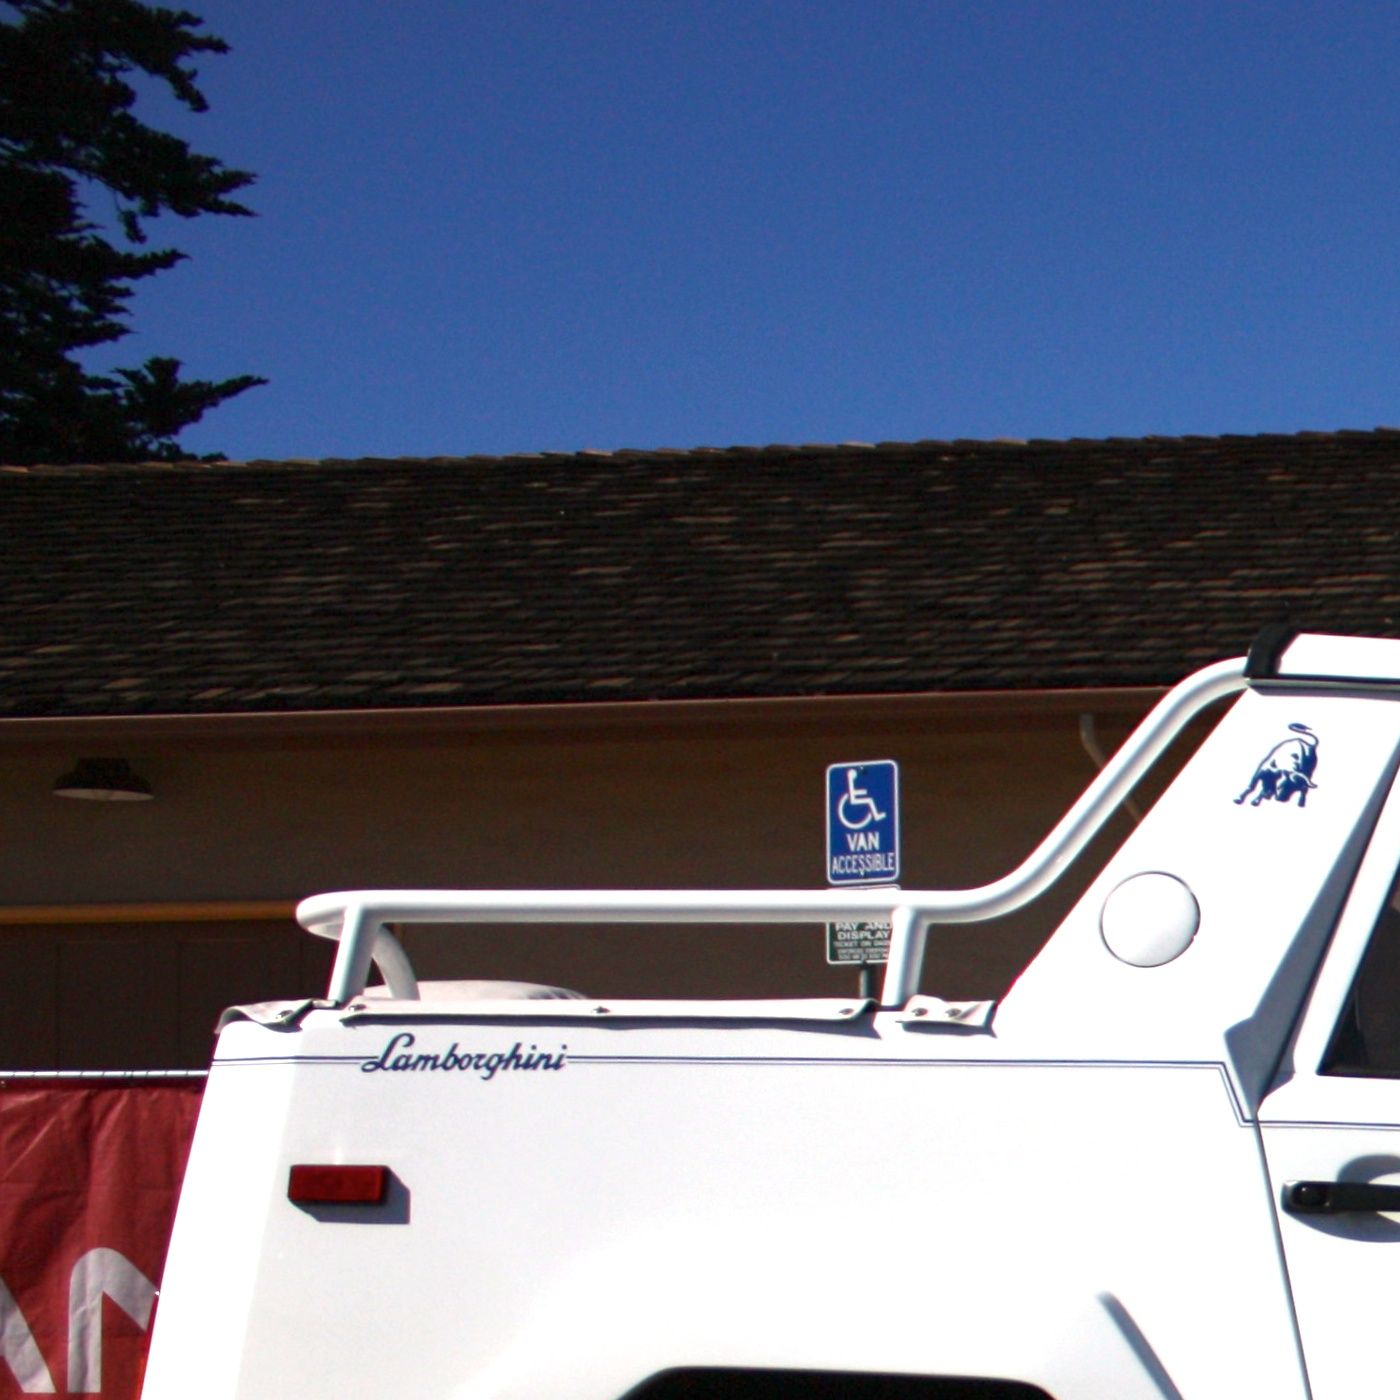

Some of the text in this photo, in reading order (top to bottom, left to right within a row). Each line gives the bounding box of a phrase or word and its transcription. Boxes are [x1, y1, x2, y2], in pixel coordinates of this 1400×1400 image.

[846, 832, 880, 851] VAN
[832, 853, 895, 874] ACCESSIBLE
[837, 930, 890, 940] DISPLAY
[361, 1032, 567, 1081] Lamborghini
